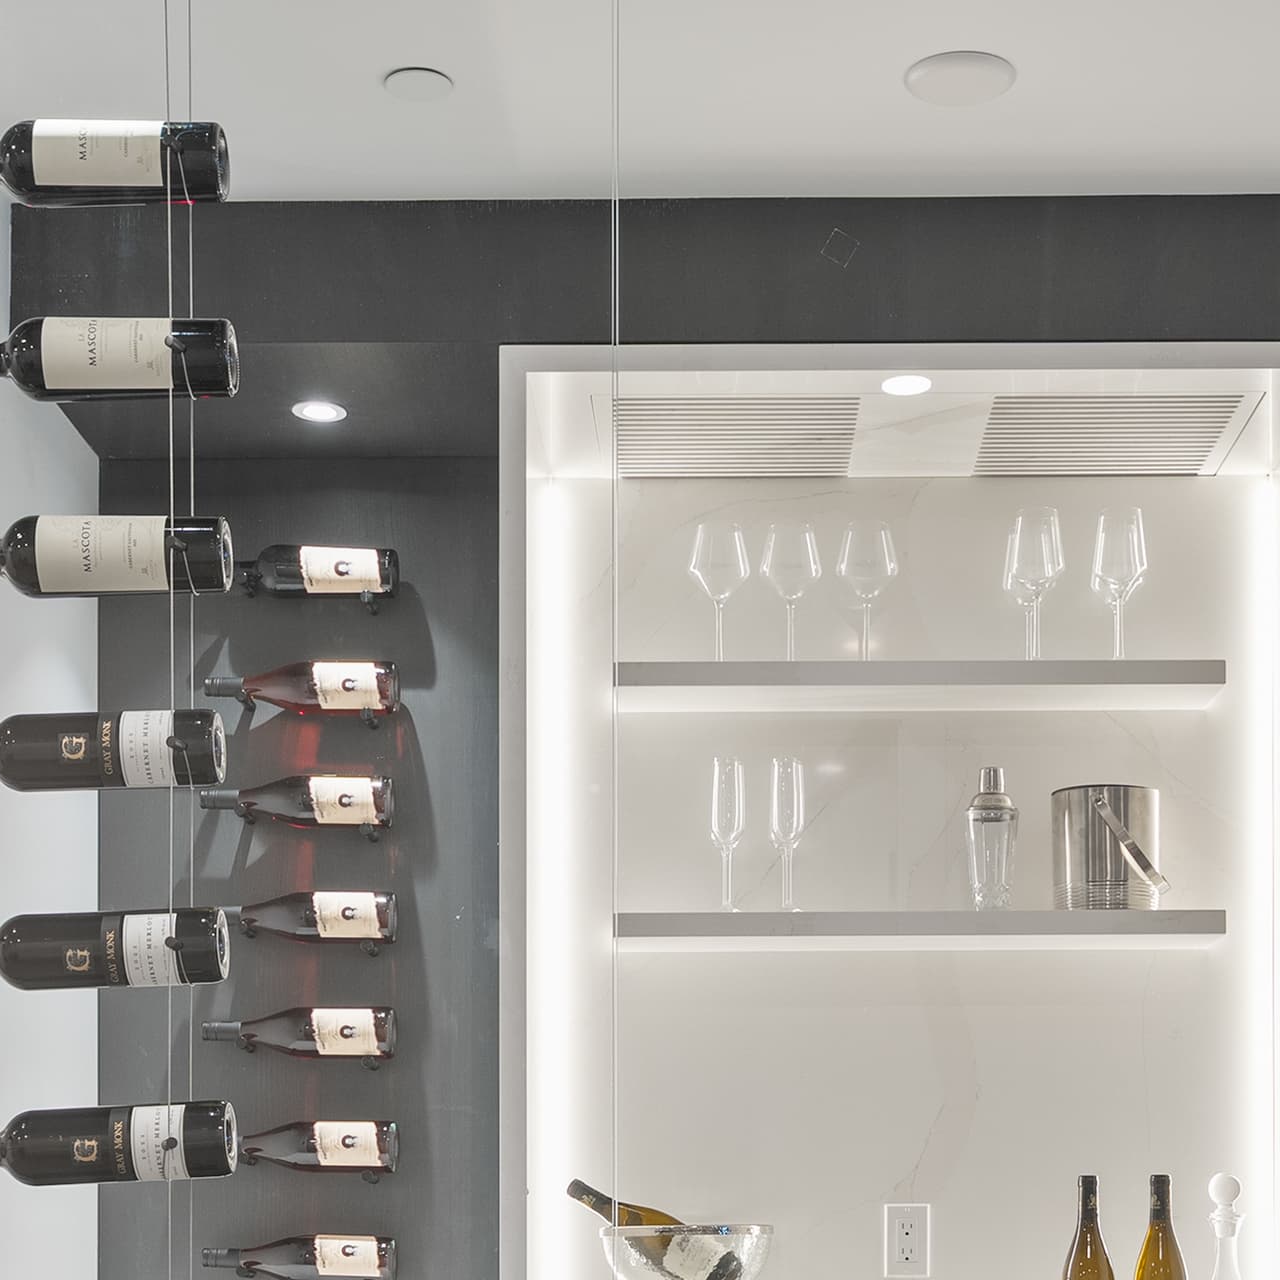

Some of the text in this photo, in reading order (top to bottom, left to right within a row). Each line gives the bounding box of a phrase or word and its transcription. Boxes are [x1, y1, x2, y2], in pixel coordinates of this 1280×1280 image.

[81, 520, 93, 573] MASCOTA
[61, 735, 87, 760] G
[100, 719, 114, 775] GRAY MONK
[65, 948, 91, 972] G
[105, 930, 119, 983] GRAY MONK
[73, 1139, 98, 1162] G
[113, 1120, 127, 1174] GRAY MONK
